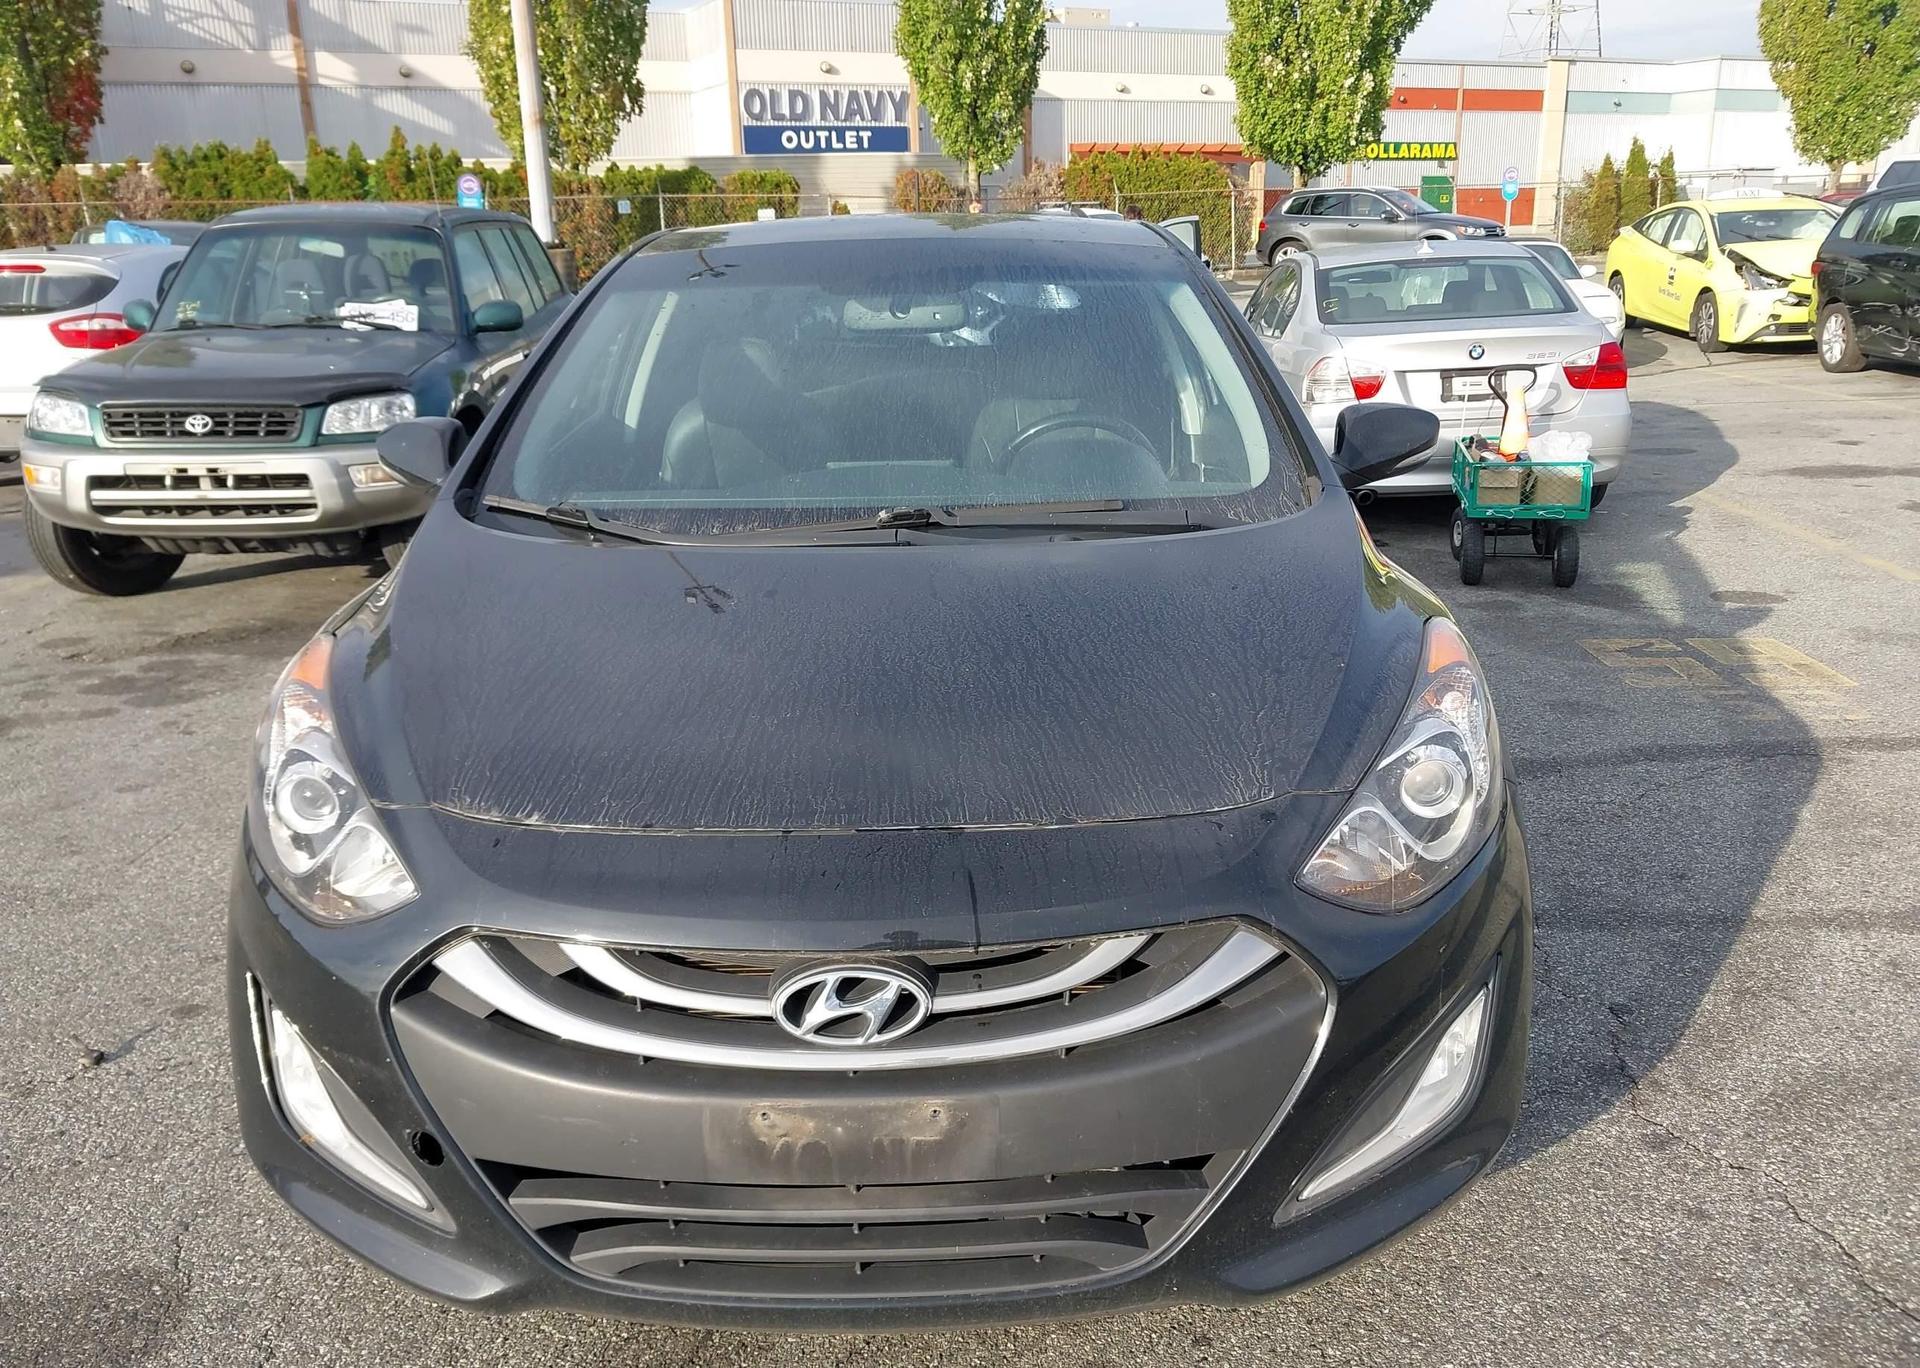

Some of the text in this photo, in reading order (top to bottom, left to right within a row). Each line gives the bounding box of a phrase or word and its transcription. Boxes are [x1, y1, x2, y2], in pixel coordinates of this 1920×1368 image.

[743, 87, 911, 123] OLD NAVY
[781, 129, 872, 150] OUTLET
[1361, 142, 1456, 158] OLLARAMA
